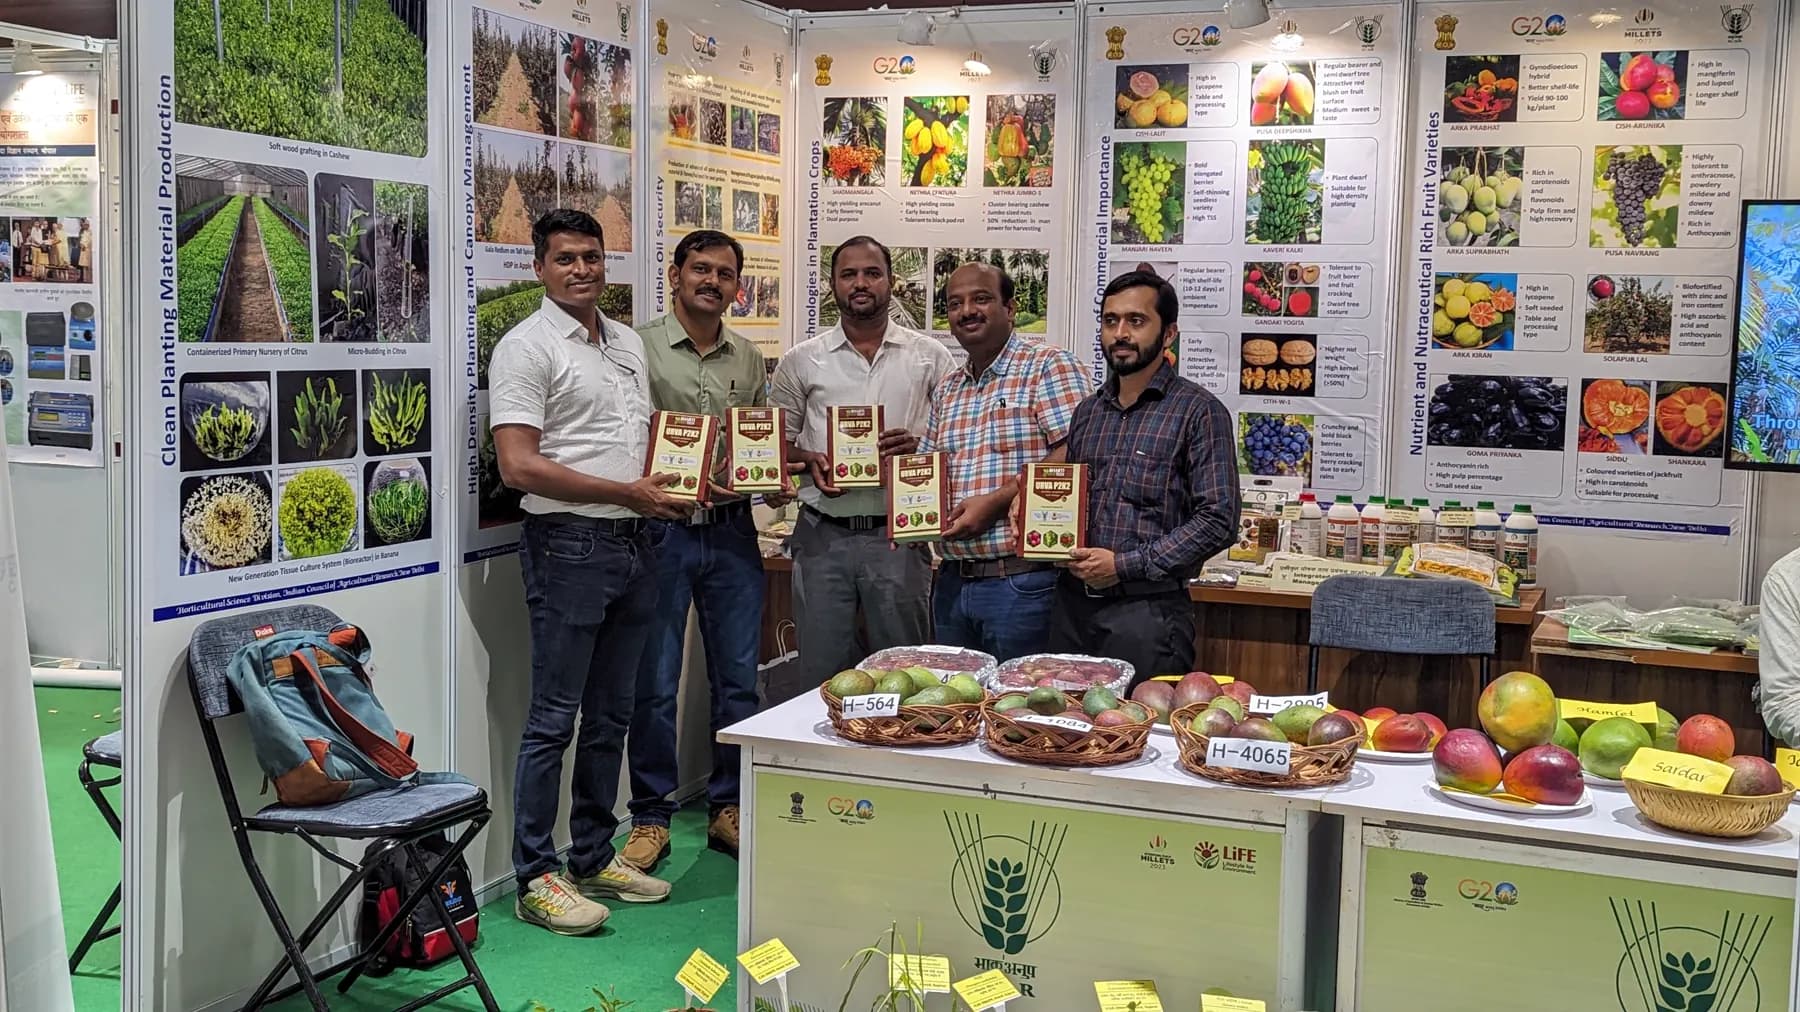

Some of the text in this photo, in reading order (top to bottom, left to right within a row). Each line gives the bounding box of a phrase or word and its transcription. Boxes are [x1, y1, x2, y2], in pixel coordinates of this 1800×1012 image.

[1511, 14, 1567, 36] G20
[268, 141, 281, 150] Soft
[299, 146, 321, 158] grafting
[322, 148, 328, 156] in
[328, 150, 350, 160] Cashew
[809, 140, 823, 178] Crops
[1096, 136, 1111, 217] Importance
[656, 176, 664, 237] Security
[807, 180, 819, 250] Plantation
[157, 74, 177, 466] Clean Planting Material Production
[806, 255, 817, 266] in
[1094, 222, 1108, 305] Commercial
[462, 64, 478, 494] High Density Planting and Canopy Management
[1409, 112, 1439, 455] Nutrient and Nutraceutical Rich Fruit Varieties
[186, 347, 308, 357] Containerized Primary Nursery of Citrus
[1451, 472, 1466, 480] pulp
[1585, 478, 1600, 486] High
[1586, 467, 1616, 475] Coloured
[1622, 492, 1659, 500] processing
[228, 575, 243, 583] New
[244, 569, 279, 580] Generation
[279, 566, 298, 575] Tissue
[299, 563, 321, 572] Culture
[321, 560, 342, 570] System
[342, 553, 374, 567] (Bioreactor)
[380, 551, 399, 559] Banana
[842, 696, 894, 713] H-564
[1211, 742, 1287, 766] H-4065
[1652, 762, 1708, 783] Sardar
[828, 797, 875, 820] G20
[1140, 855, 1174, 864] MILLETS
[1223, 846, 1256, 863] LiFE
[1458, 880, 1518, 905] G20
